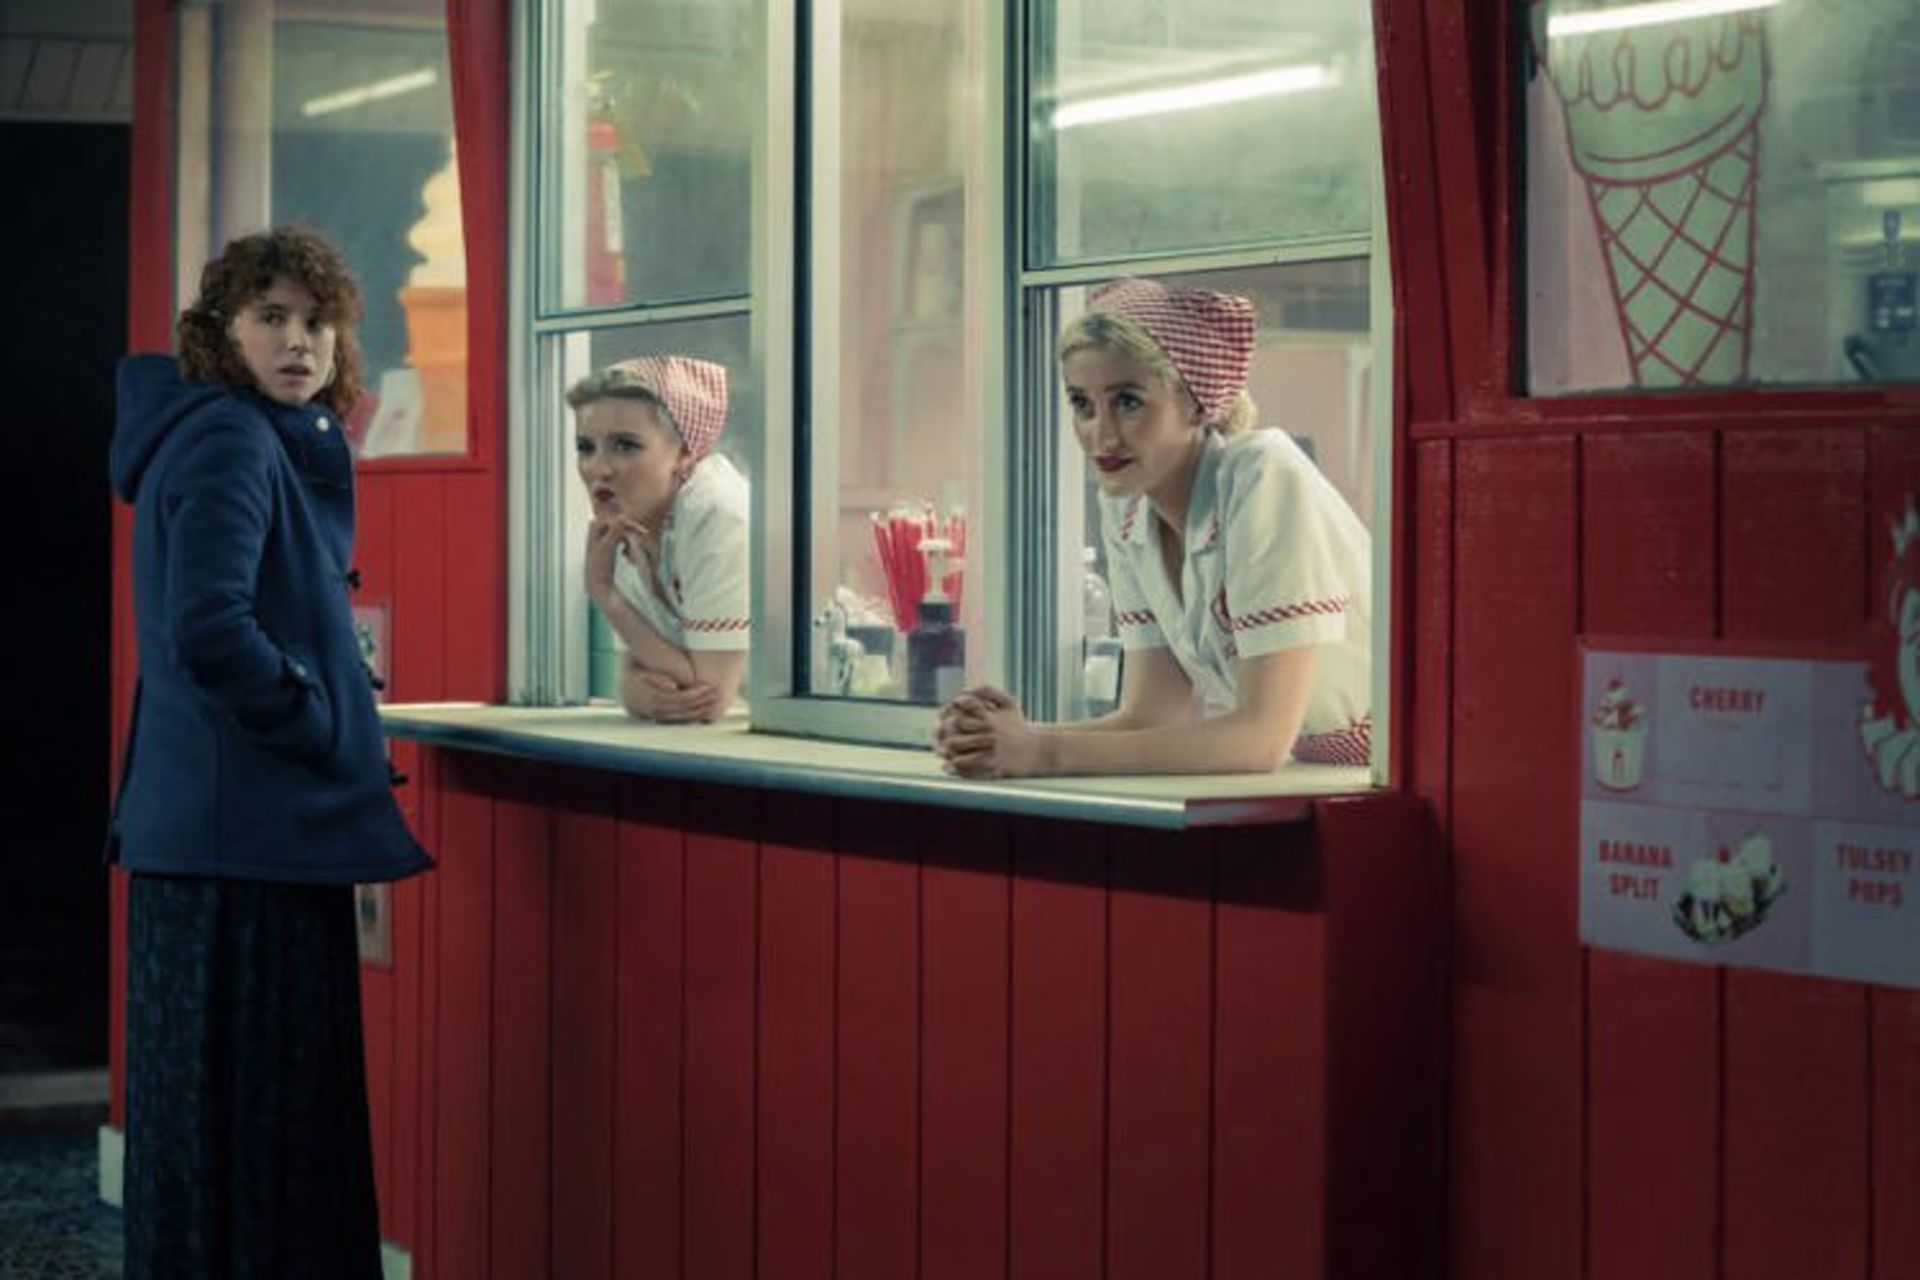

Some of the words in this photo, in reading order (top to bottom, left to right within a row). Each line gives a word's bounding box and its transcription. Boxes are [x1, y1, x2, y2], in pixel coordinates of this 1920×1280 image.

[1689, 686, 1766, 712] CHERRY
[1598, 840, 1673, 869] BANANA
[1837, 843, 1911, 873] TULSEY
[1610, 874, 1660, 901] SPLIT
